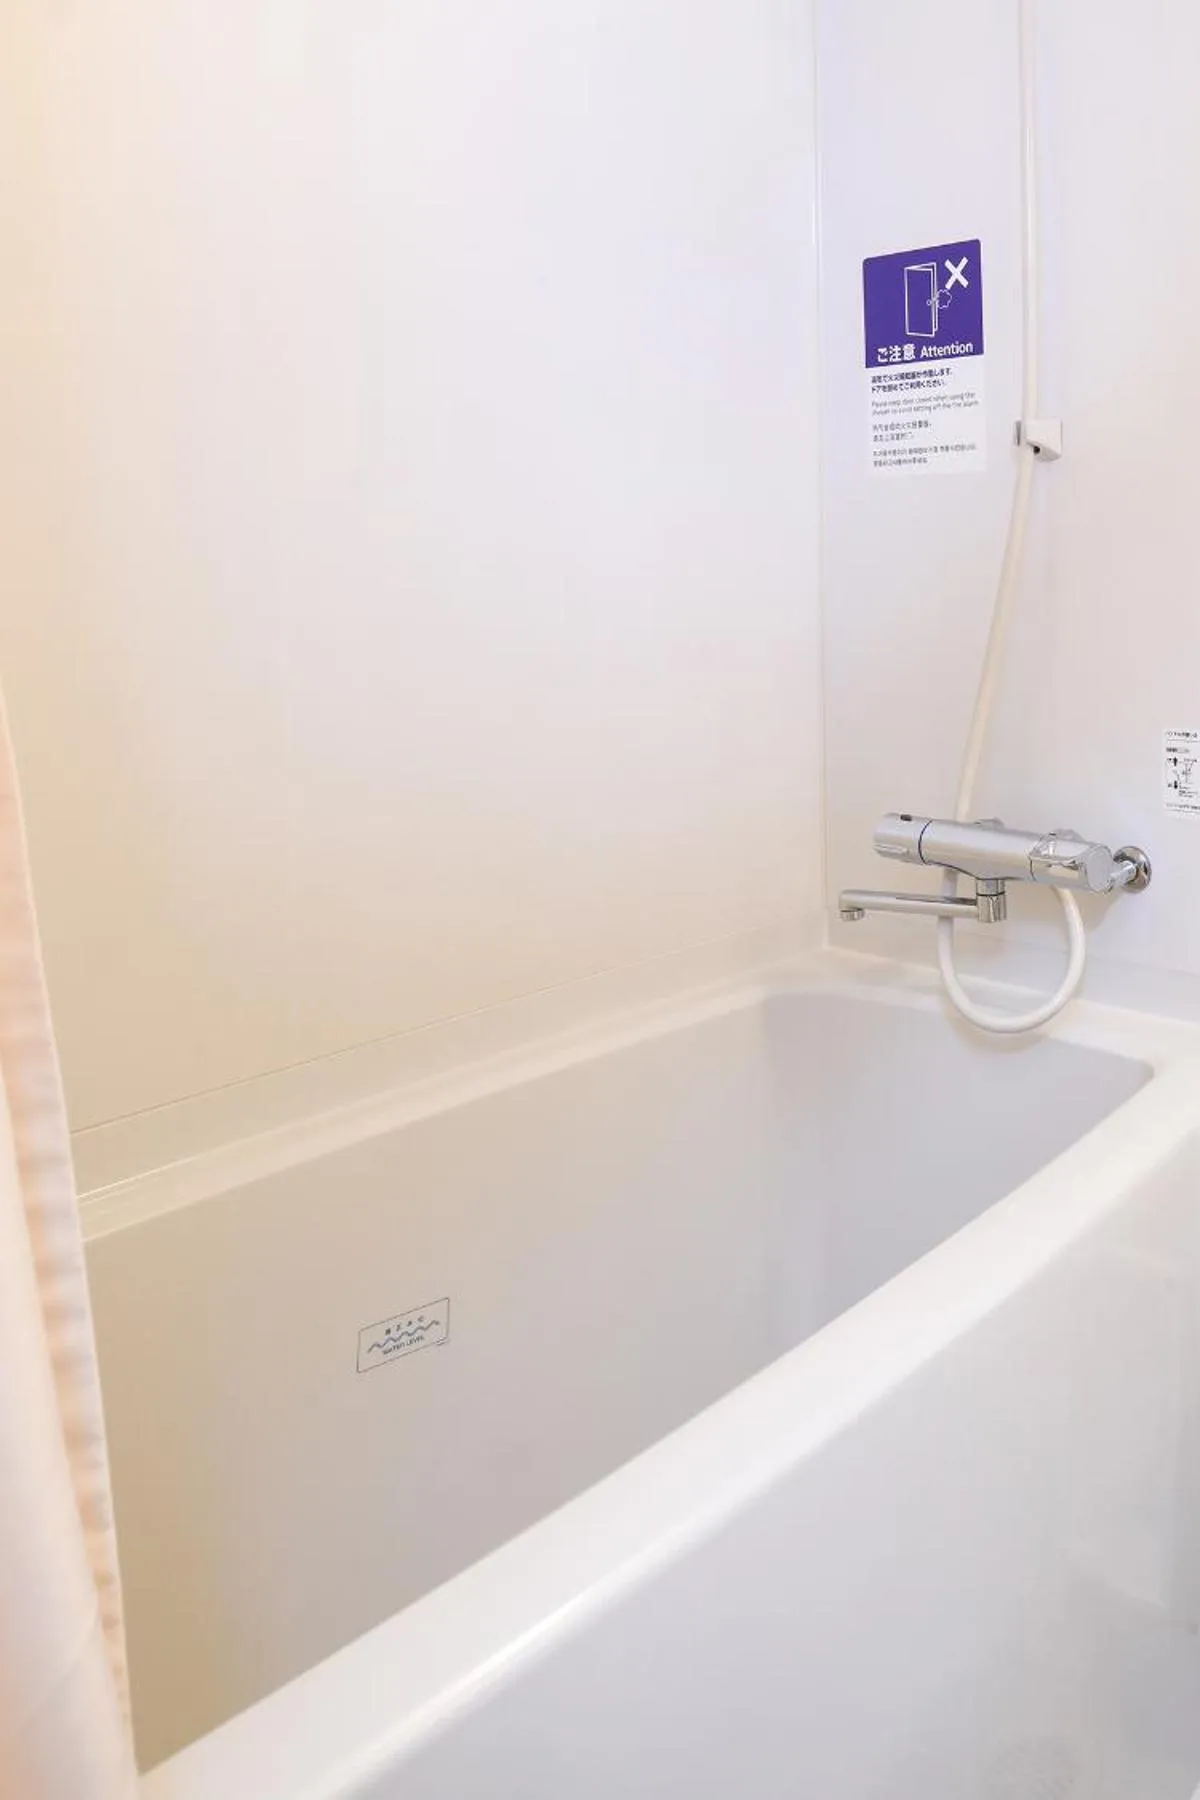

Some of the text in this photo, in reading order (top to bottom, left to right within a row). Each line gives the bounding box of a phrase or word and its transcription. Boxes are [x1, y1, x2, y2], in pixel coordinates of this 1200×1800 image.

[877, 341, 974, 362] ご注意 Attention
